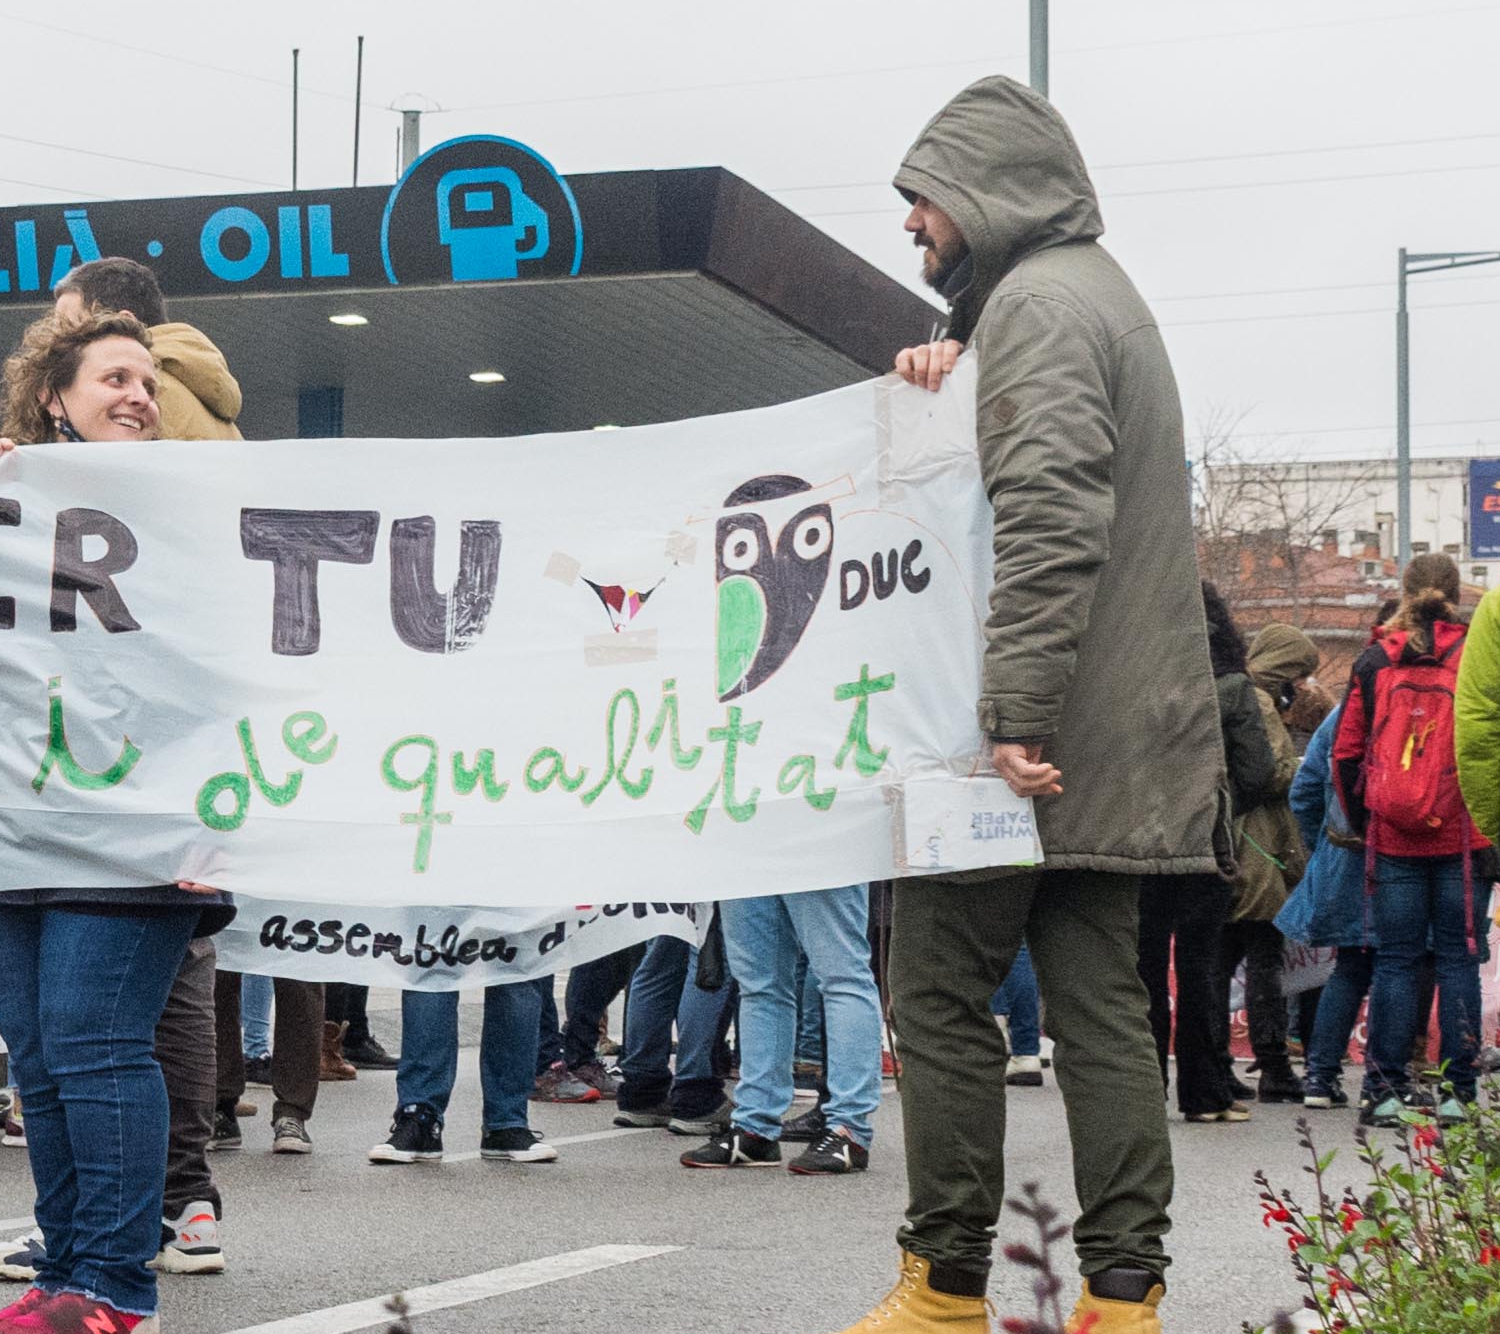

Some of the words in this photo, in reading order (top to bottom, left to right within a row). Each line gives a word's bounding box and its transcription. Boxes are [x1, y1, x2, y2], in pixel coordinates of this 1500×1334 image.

[199, 204, 351, 283] OIL
[239, 506, 502, 656] TU
[839, 538, 932, 611] DUC
[31, 676, 142, 794] i
[197, 710, 338, 832] de
[381, 664, 896, 873] qualitat
[972, 812, 1031, 825] PAPER
[973, 826, 1033, 840] WHITE
[259, 915, 519, 968] assemblea
